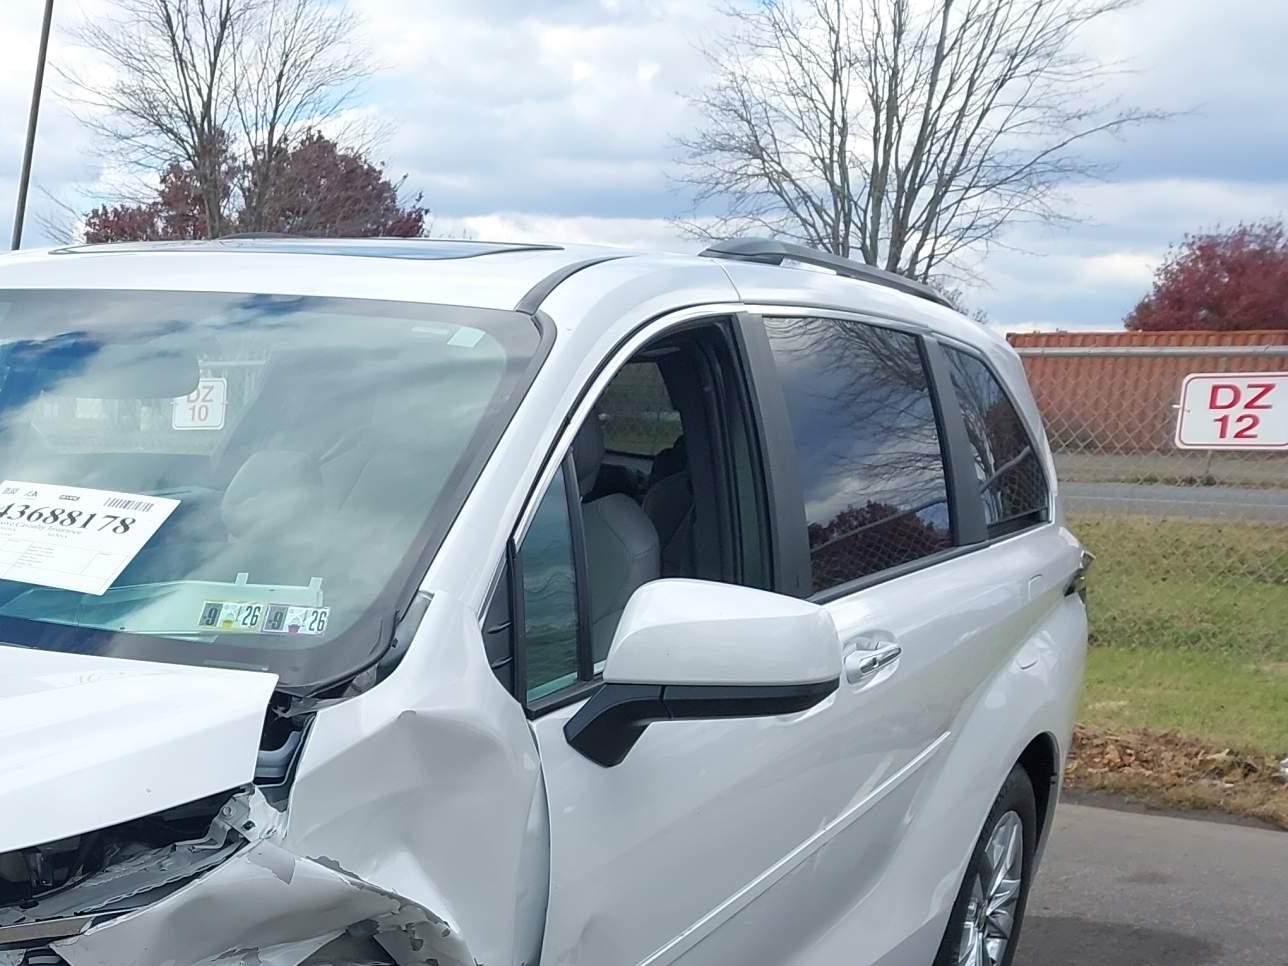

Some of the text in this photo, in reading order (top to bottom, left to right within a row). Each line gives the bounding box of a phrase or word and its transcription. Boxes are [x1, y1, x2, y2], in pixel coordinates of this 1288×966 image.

[1209, 384, 1276, 409] DZ
[189, 404, 208, 421] 10
[1213, 414, 1260, 438] 12
[241, 605, 261, 626] 26
[308, 610, 327, 631] 26
